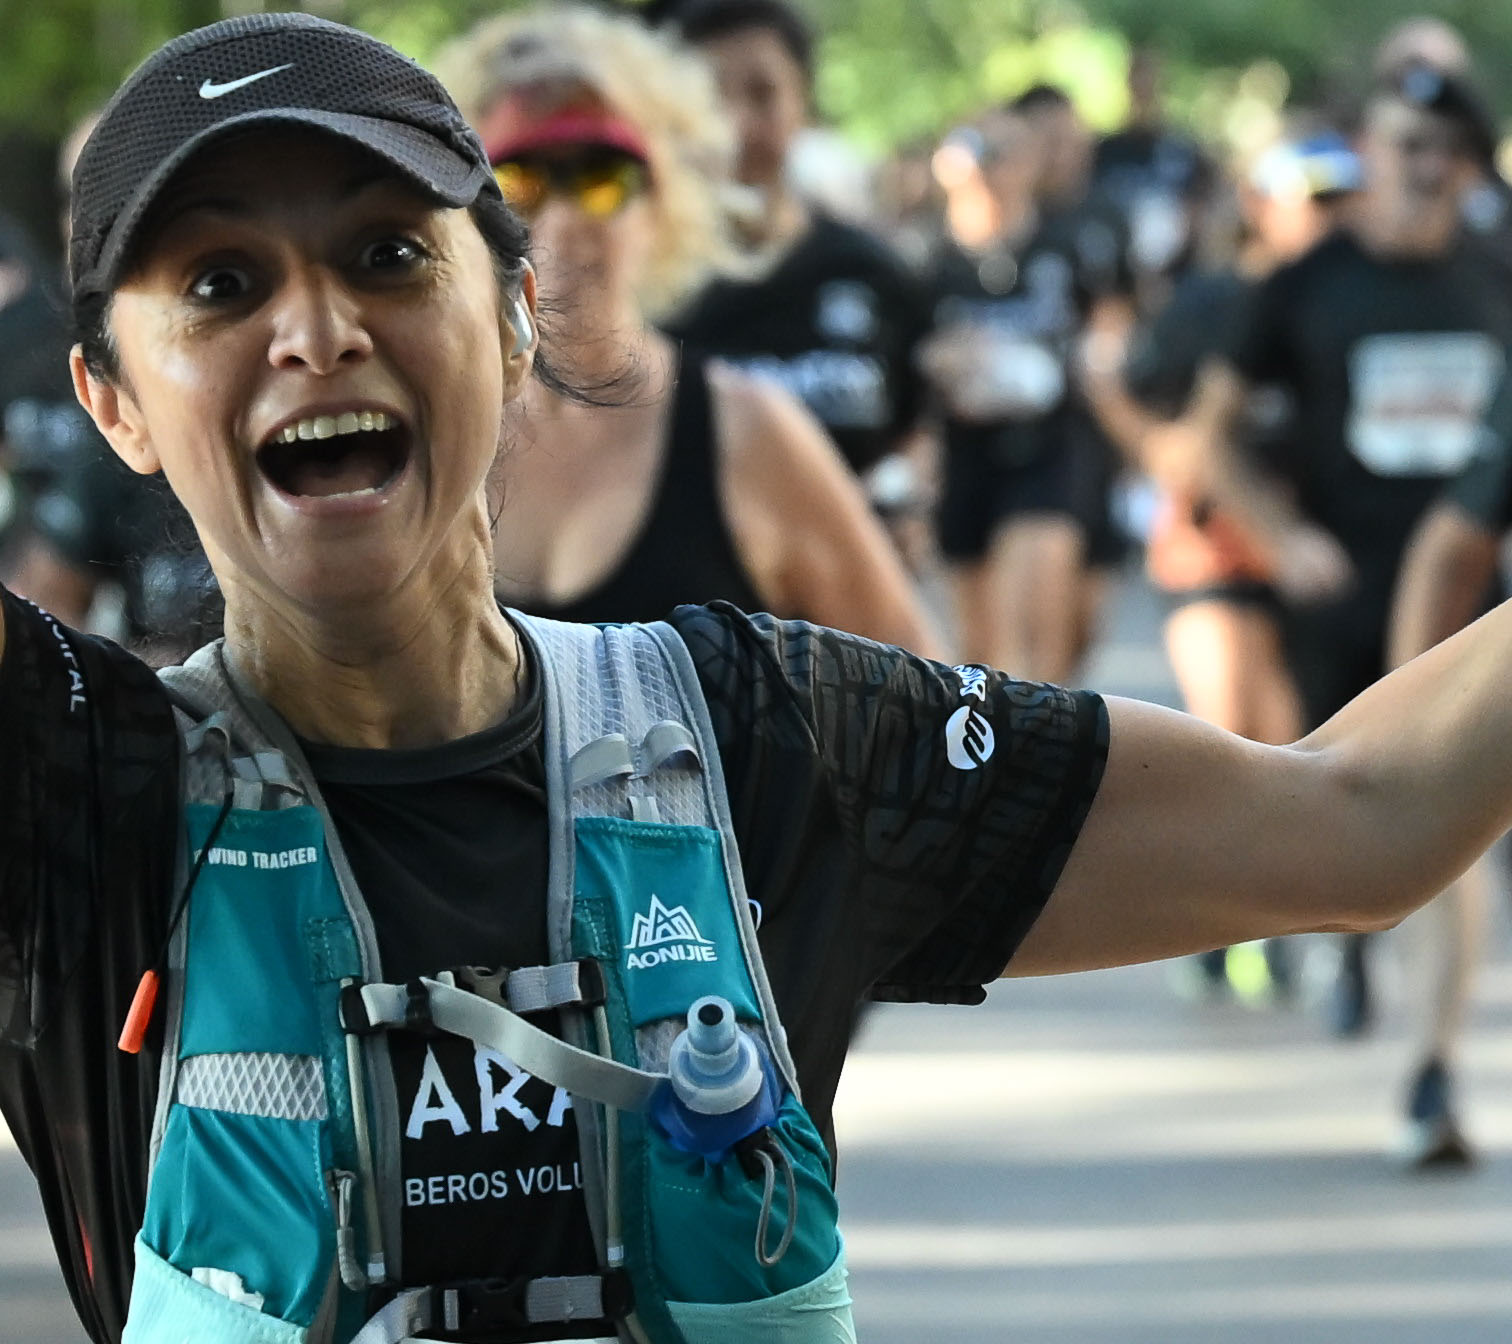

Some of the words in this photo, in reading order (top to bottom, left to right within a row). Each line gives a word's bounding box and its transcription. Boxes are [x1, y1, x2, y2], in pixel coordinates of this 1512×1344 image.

[207, 846, 248, 867] WIND
[251, 846, 317, 869] TRACKER
[626, 944, 718, 970] AONIJIE
[405, 1171, 508, 1207] BEROS
